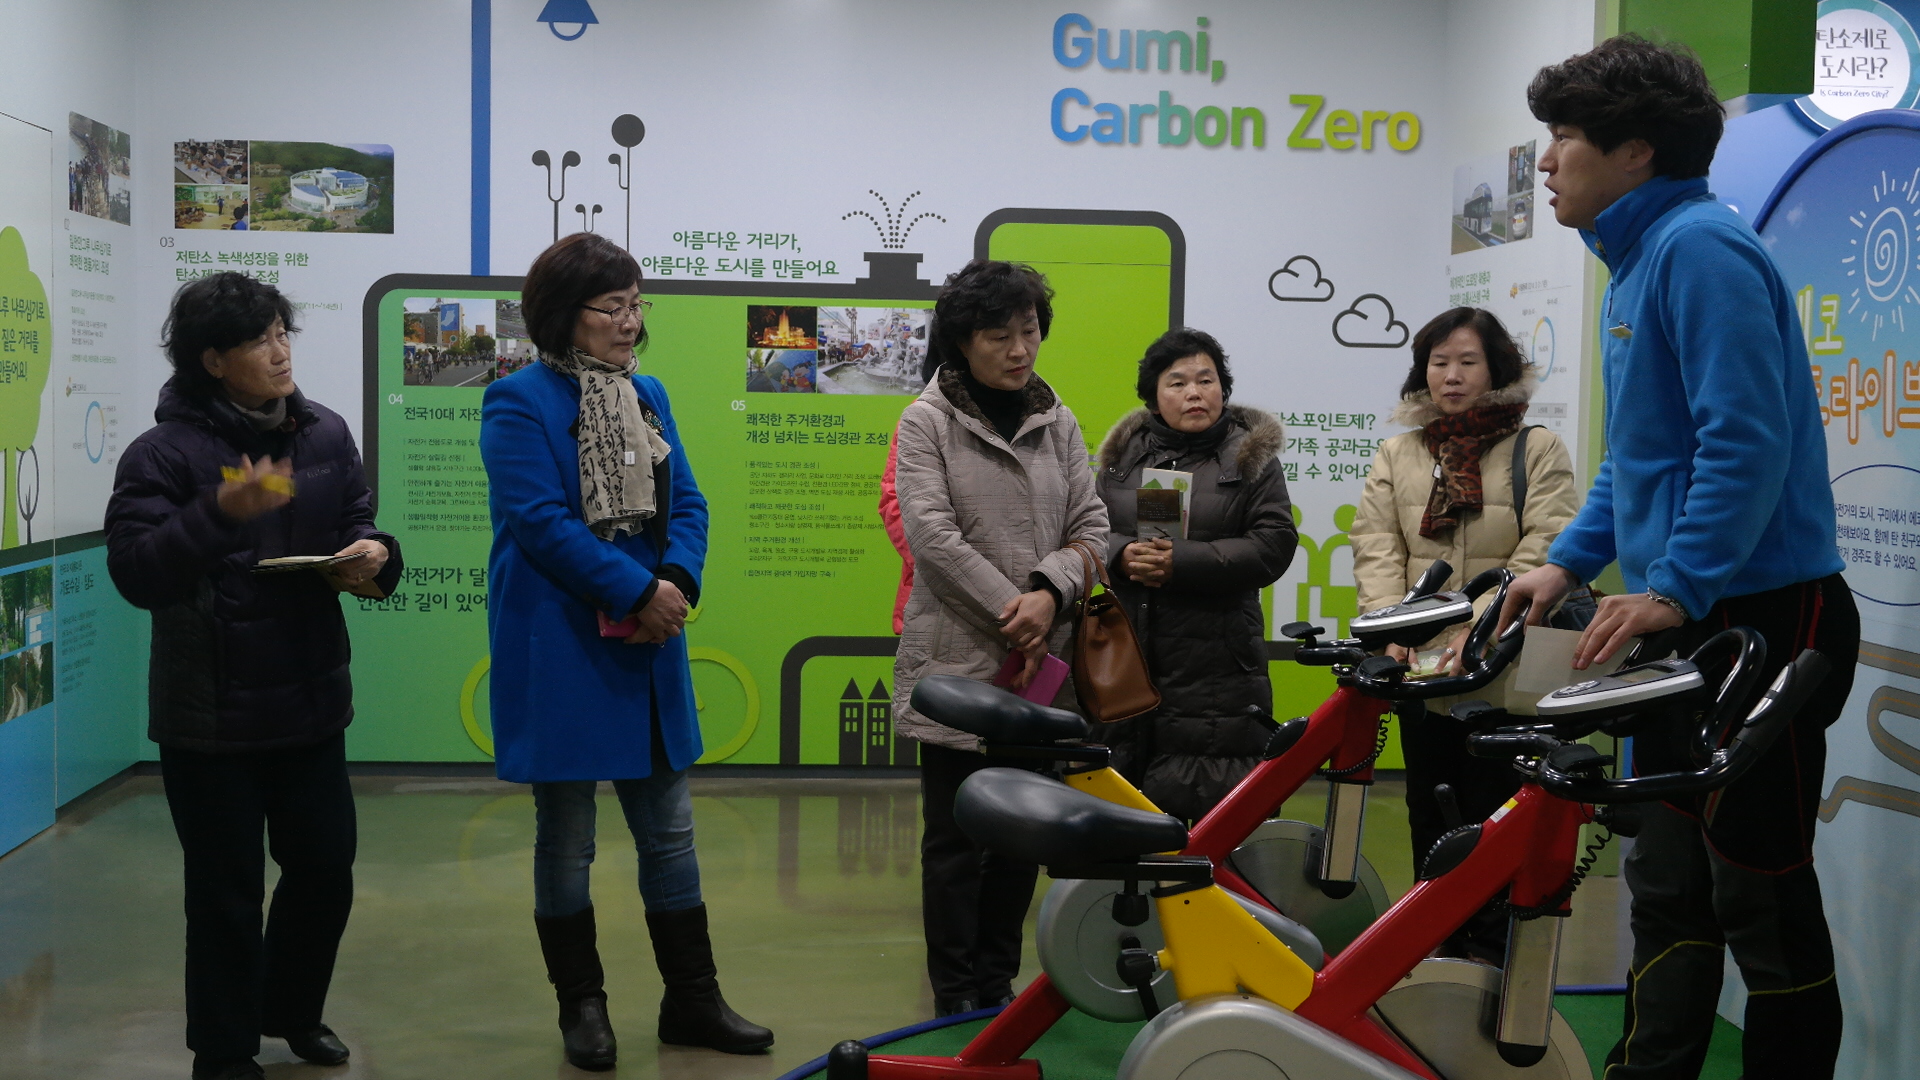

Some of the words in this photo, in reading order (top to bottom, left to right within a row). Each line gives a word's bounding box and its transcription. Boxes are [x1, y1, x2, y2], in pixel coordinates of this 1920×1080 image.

[1052, 13, 1225, 83] Gumi,
[1815, 27, 1890, 50] 탄소제로
[1820, 55, 1888, 80] 도시란?
[1827, 89, 1851, 97] Carbon
[1871, 90, 1890, 98] City?
[1050, 88, 1264, 147] Carbon
[1287, 94, 1421, 151] Zero
[160, 237, 174, 248] 03
[673, 231, 740, 250] 아름다운
[747, 233, 801, 253] 거리가,
[176, 250, 213, 264] 저탄소
[217, 252, 279, 266] 녹색성장을
[284, 252, 309, 267] 위한
[641, 256, 707, 276] 아름다운
[715, 259, 766, 277] 도시를
[772, 259, 839, 279] 만들어요
[255, 270, 279, 284] 조성
[12, 297, 45, 322] 나무심기로
[1797, 284, 1844, 356] 코
[1, 329, 16, 351] 짙은
[19, 330, 39, 353] 거리를
[388, 393, 404, 405] 04
[731, 400, 746, 411] 05
[1809, 349, 1920, 445] 라이브
[404, 407, 455, 421] 전국10대
[746, 413, 782, 427] 쾌적한
[785, 414, 845, 427] 주거환경과
[746, 431, 769, 444] 개성
[774, 431, 809, 444] 넘치는
[813, 432, 861, 445] 도심경관
[865, 432, 888, 446] 조성
[1287, 438, 1319, 456] 가족
[1304, 464, 1322, 479] 수
[1835, 503, 1857, 519] 전거의
[1877, 507, 1906, 525] 구미에서
[1874, 528, 1889, 545] 함께
[1891, 531, 1899, 546] 탄
[1852, 548, 1872, 563] 경주도
[1874, 551, 1881, 566] 할
[1883, 552, 1891, 567] 수
[415, 593, 448, 612] 길이
